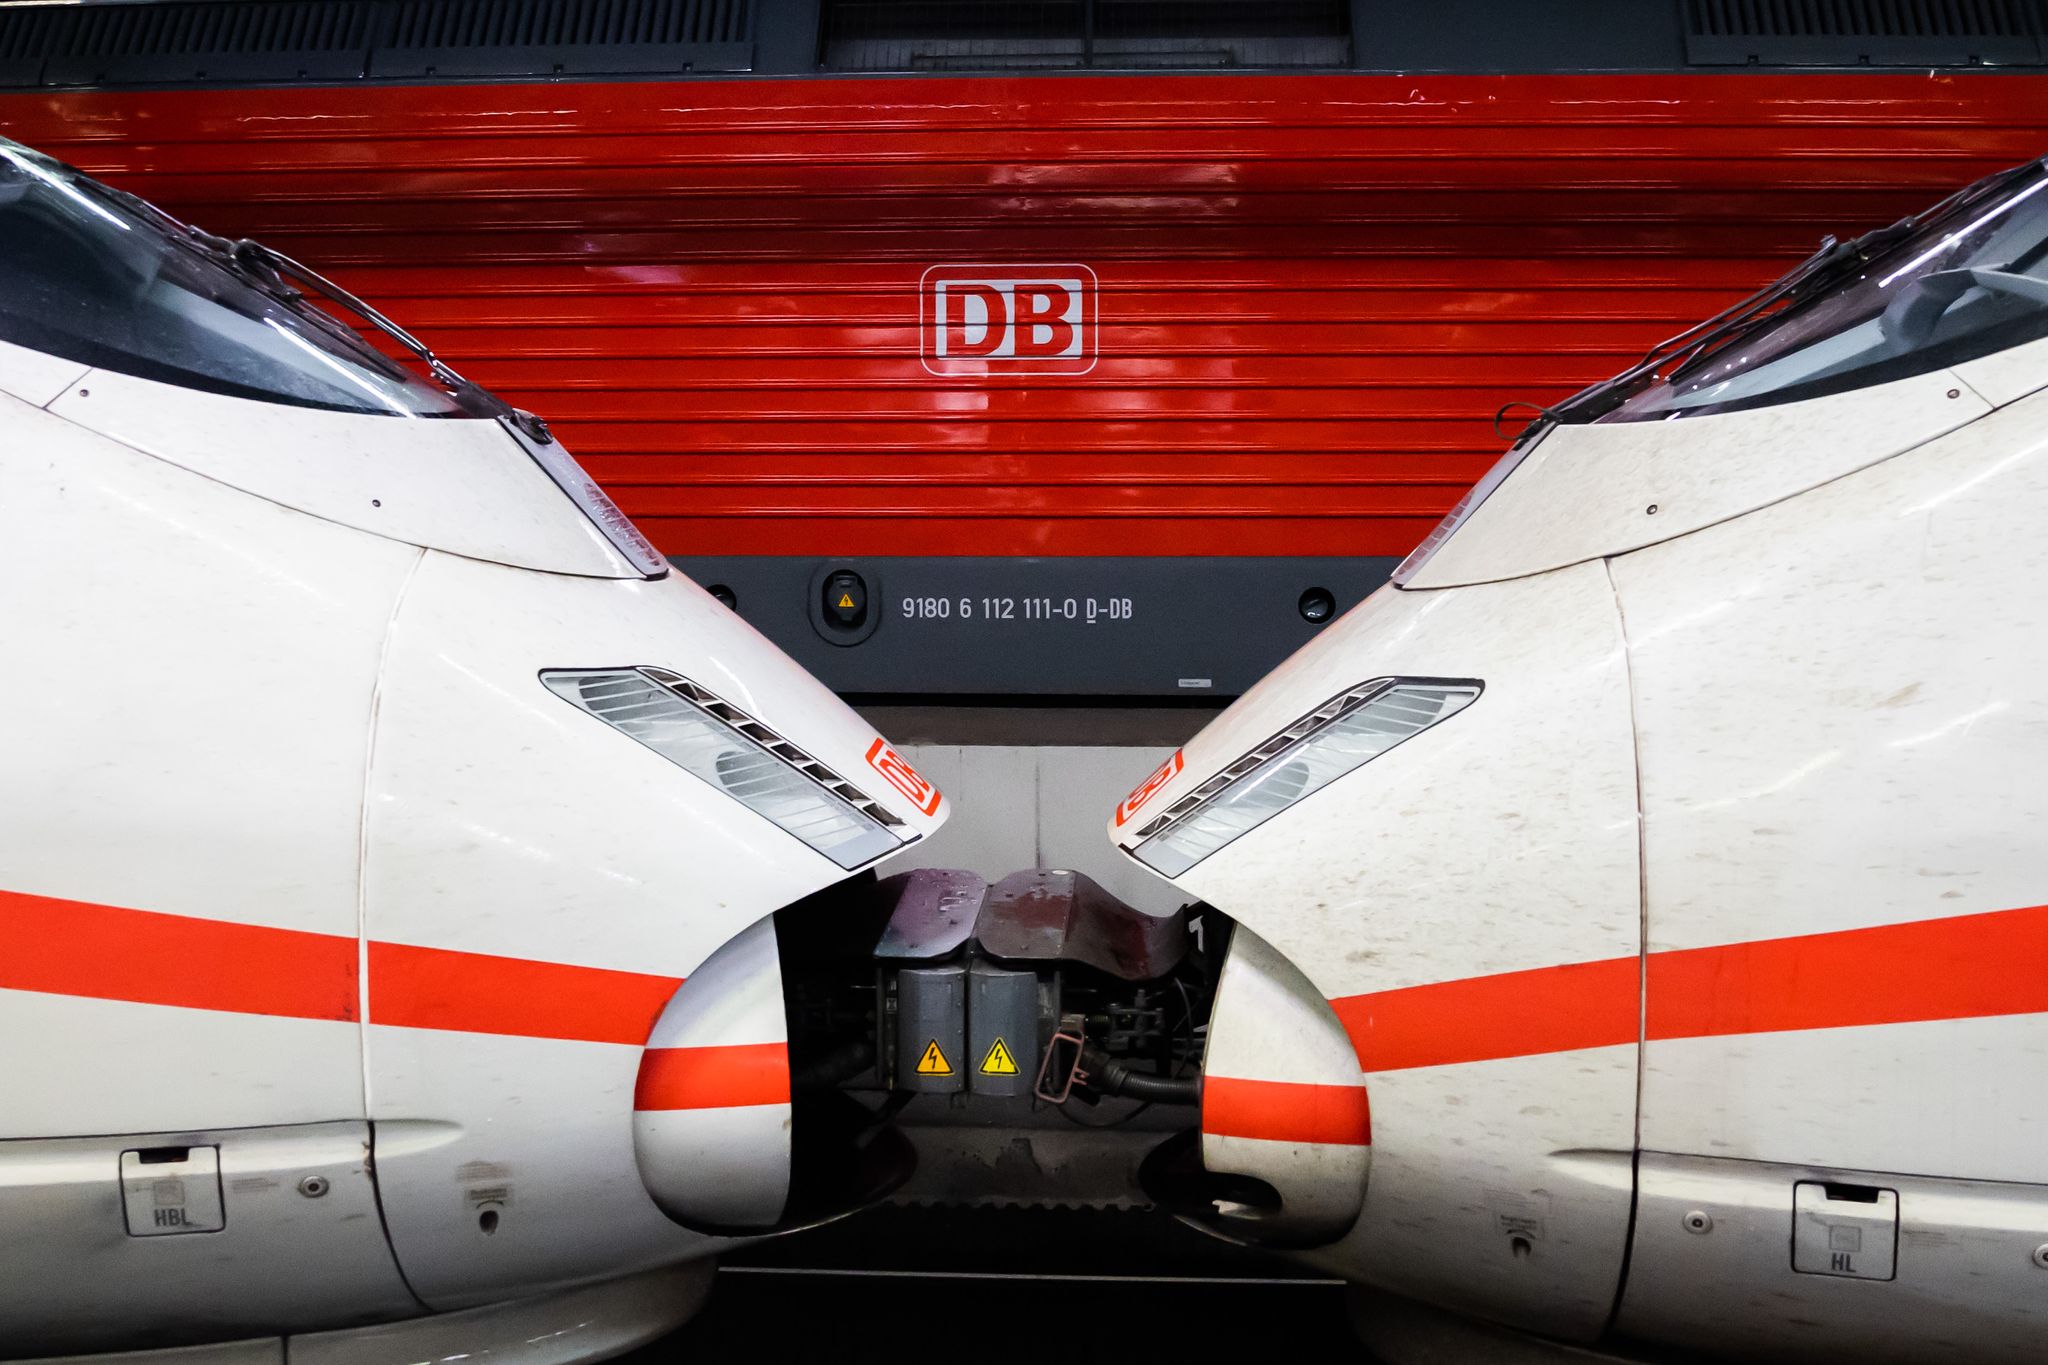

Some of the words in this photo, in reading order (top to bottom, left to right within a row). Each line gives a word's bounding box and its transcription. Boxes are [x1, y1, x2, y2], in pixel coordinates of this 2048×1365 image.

[943, 282, 1076, 358] DB
[902, 597, 950, 619] 9180
[959, 598, 972, 619] 6
[982, 598, 1015, 619] 112
[1023, 598, 1078, 619] 111-0
[1086, 598, 1133, 624] D-DB
[876, 746, 933, 806] DB
[153, 1207, 193, 1227] HBL
[1830, 1252, 1857, 1274] HL
